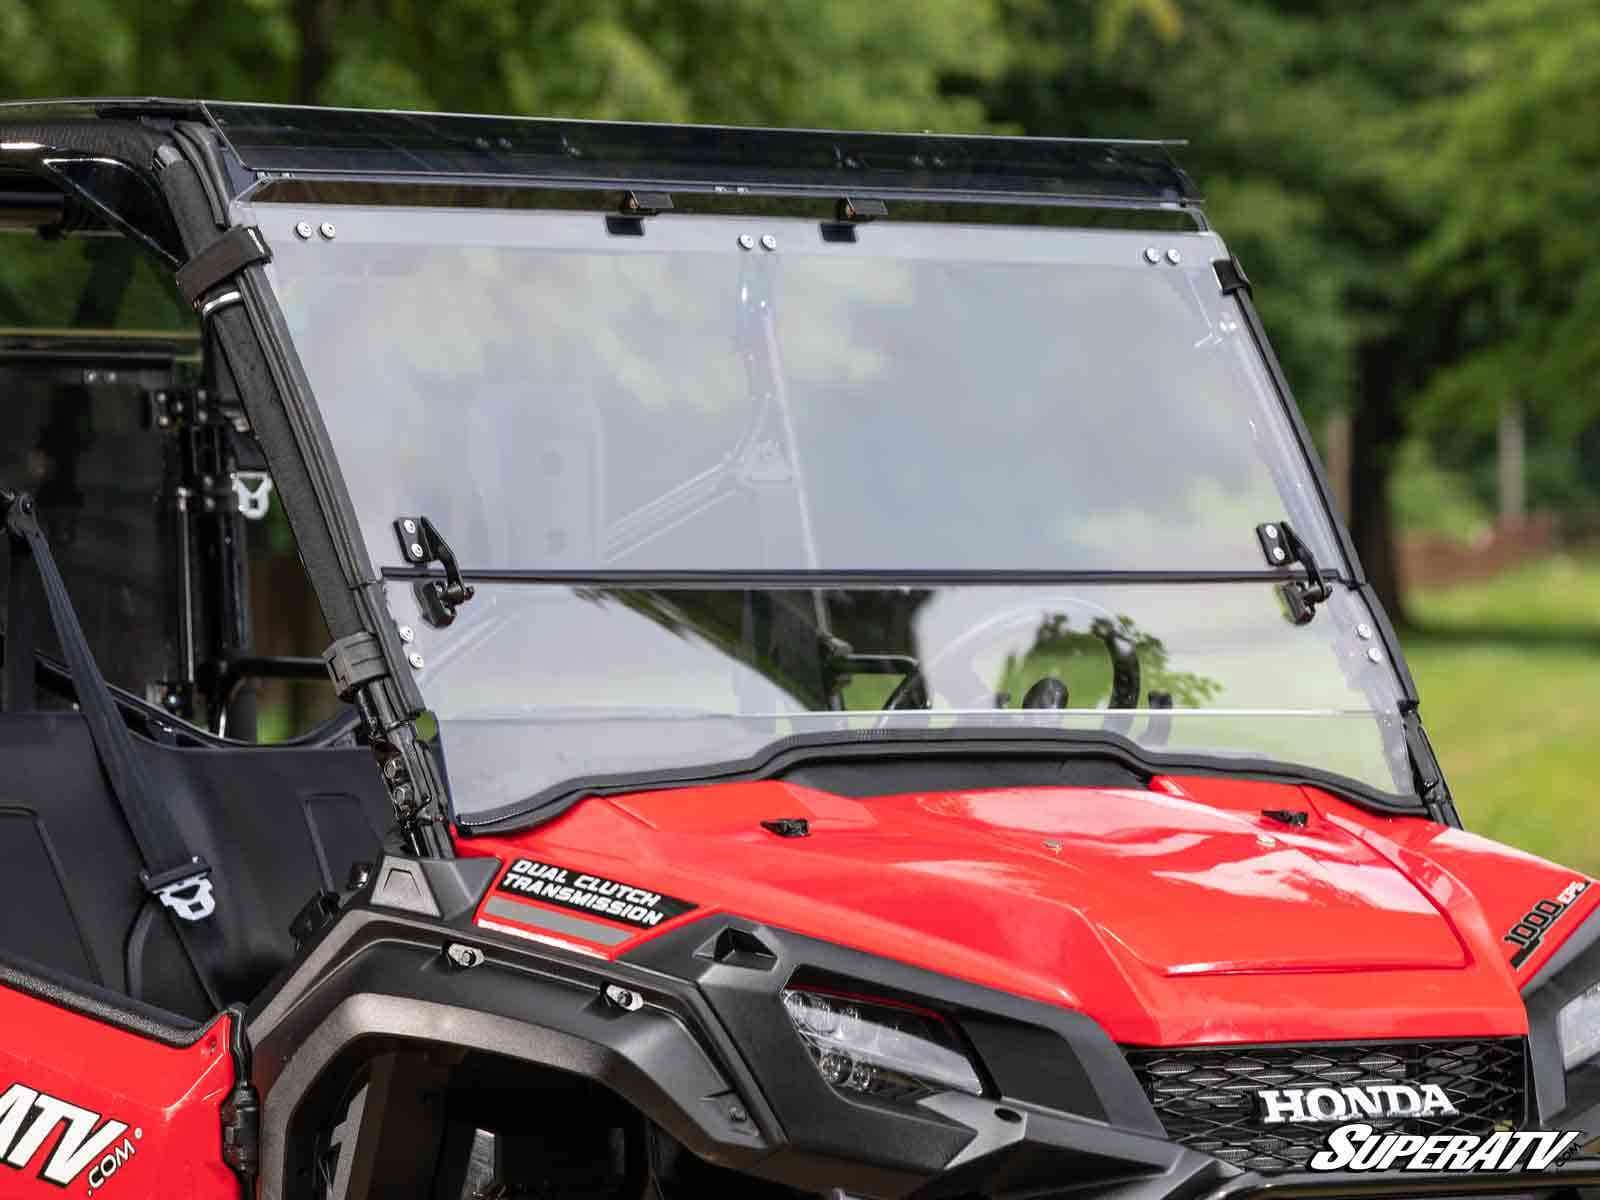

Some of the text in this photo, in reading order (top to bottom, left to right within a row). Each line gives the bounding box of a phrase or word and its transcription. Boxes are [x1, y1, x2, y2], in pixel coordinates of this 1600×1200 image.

[503, 872, 663, 926] TRANSMISSION
[512, 859, 661, 908] DUAL CLUTCH
[1504, 899, 1563, 946] 1000
[1258, 1084, 1459, 1123] HONDA
